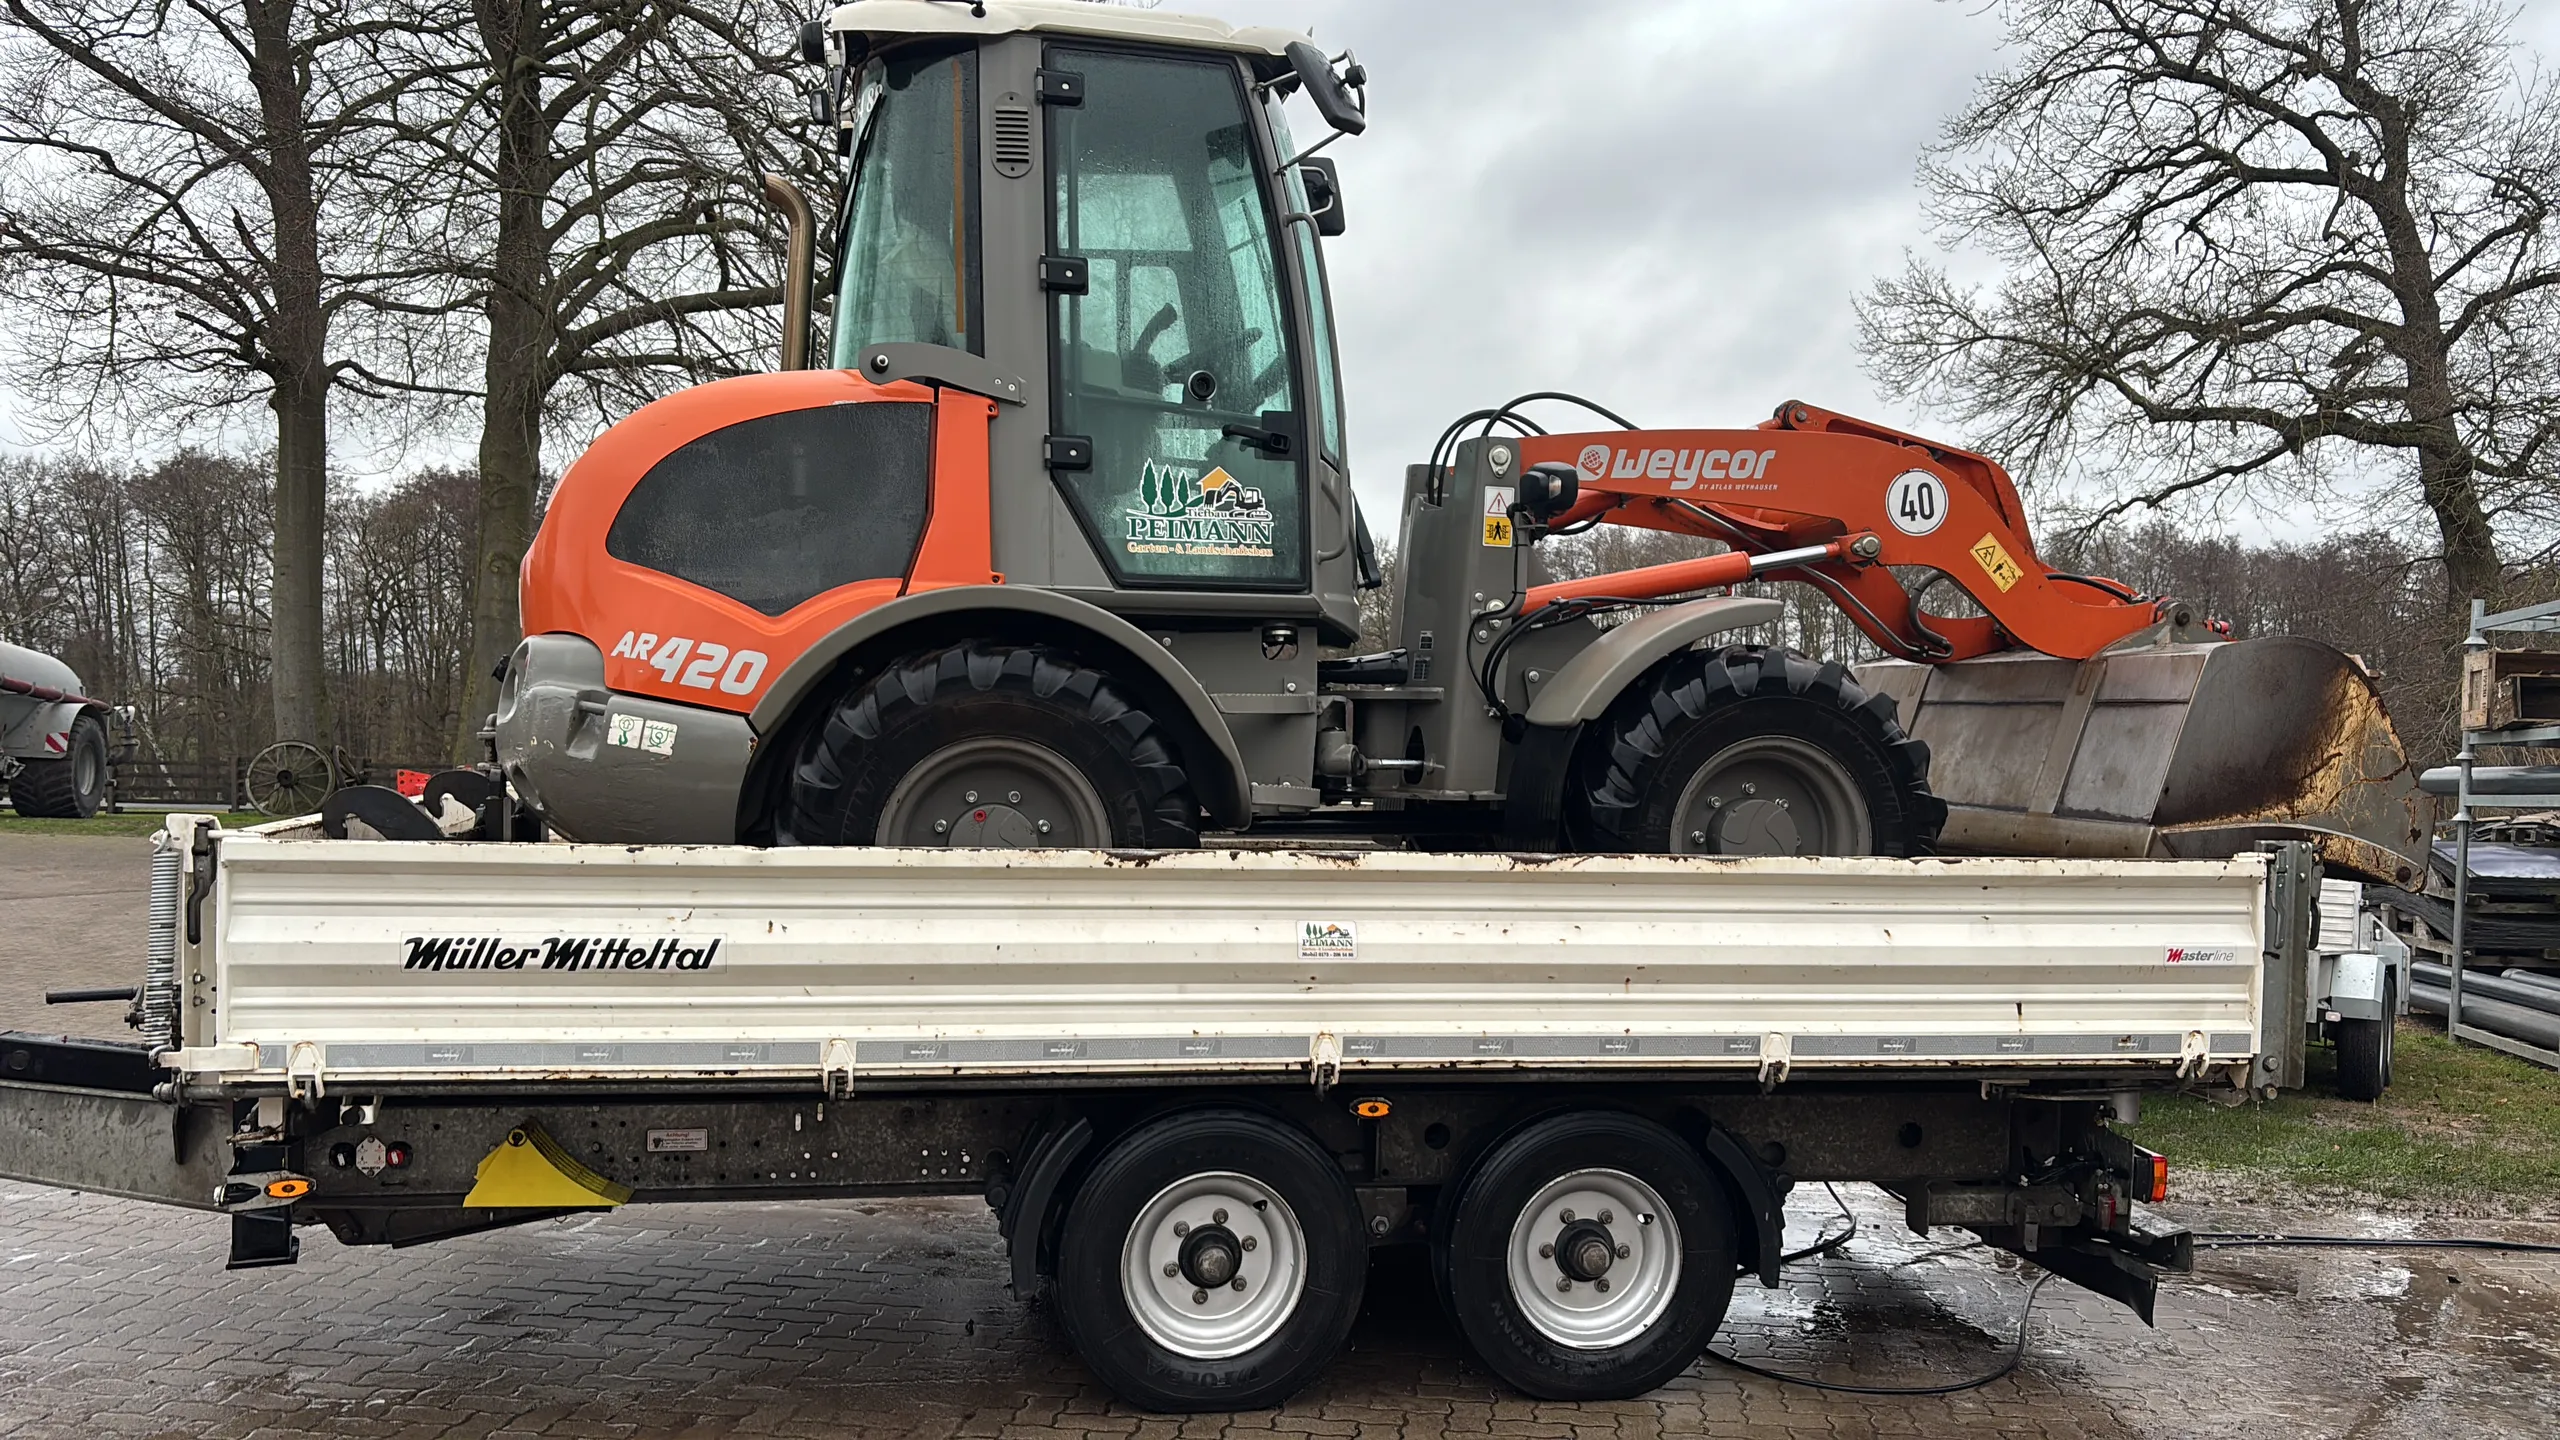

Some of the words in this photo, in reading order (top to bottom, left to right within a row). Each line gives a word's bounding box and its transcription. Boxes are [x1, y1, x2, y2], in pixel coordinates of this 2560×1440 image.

[1610, 449, 1776, 490] weycor
[1900, 482, 1934, 522] 40
[1187, 508, 1228, 518] Tiefbau
[1127, 517, 1273, 543] PEIMANN
[1175, 544, 1184, 554] &
[1186, 544, 1273, 556] Landschaftsbau
[1302, 938, 1353, 947] PEIMANN
[404, 937, 540, 971] Müller
[541, 937, 722, 971] Mitteltal
[2166, 947, 2234, 963] Masterline
